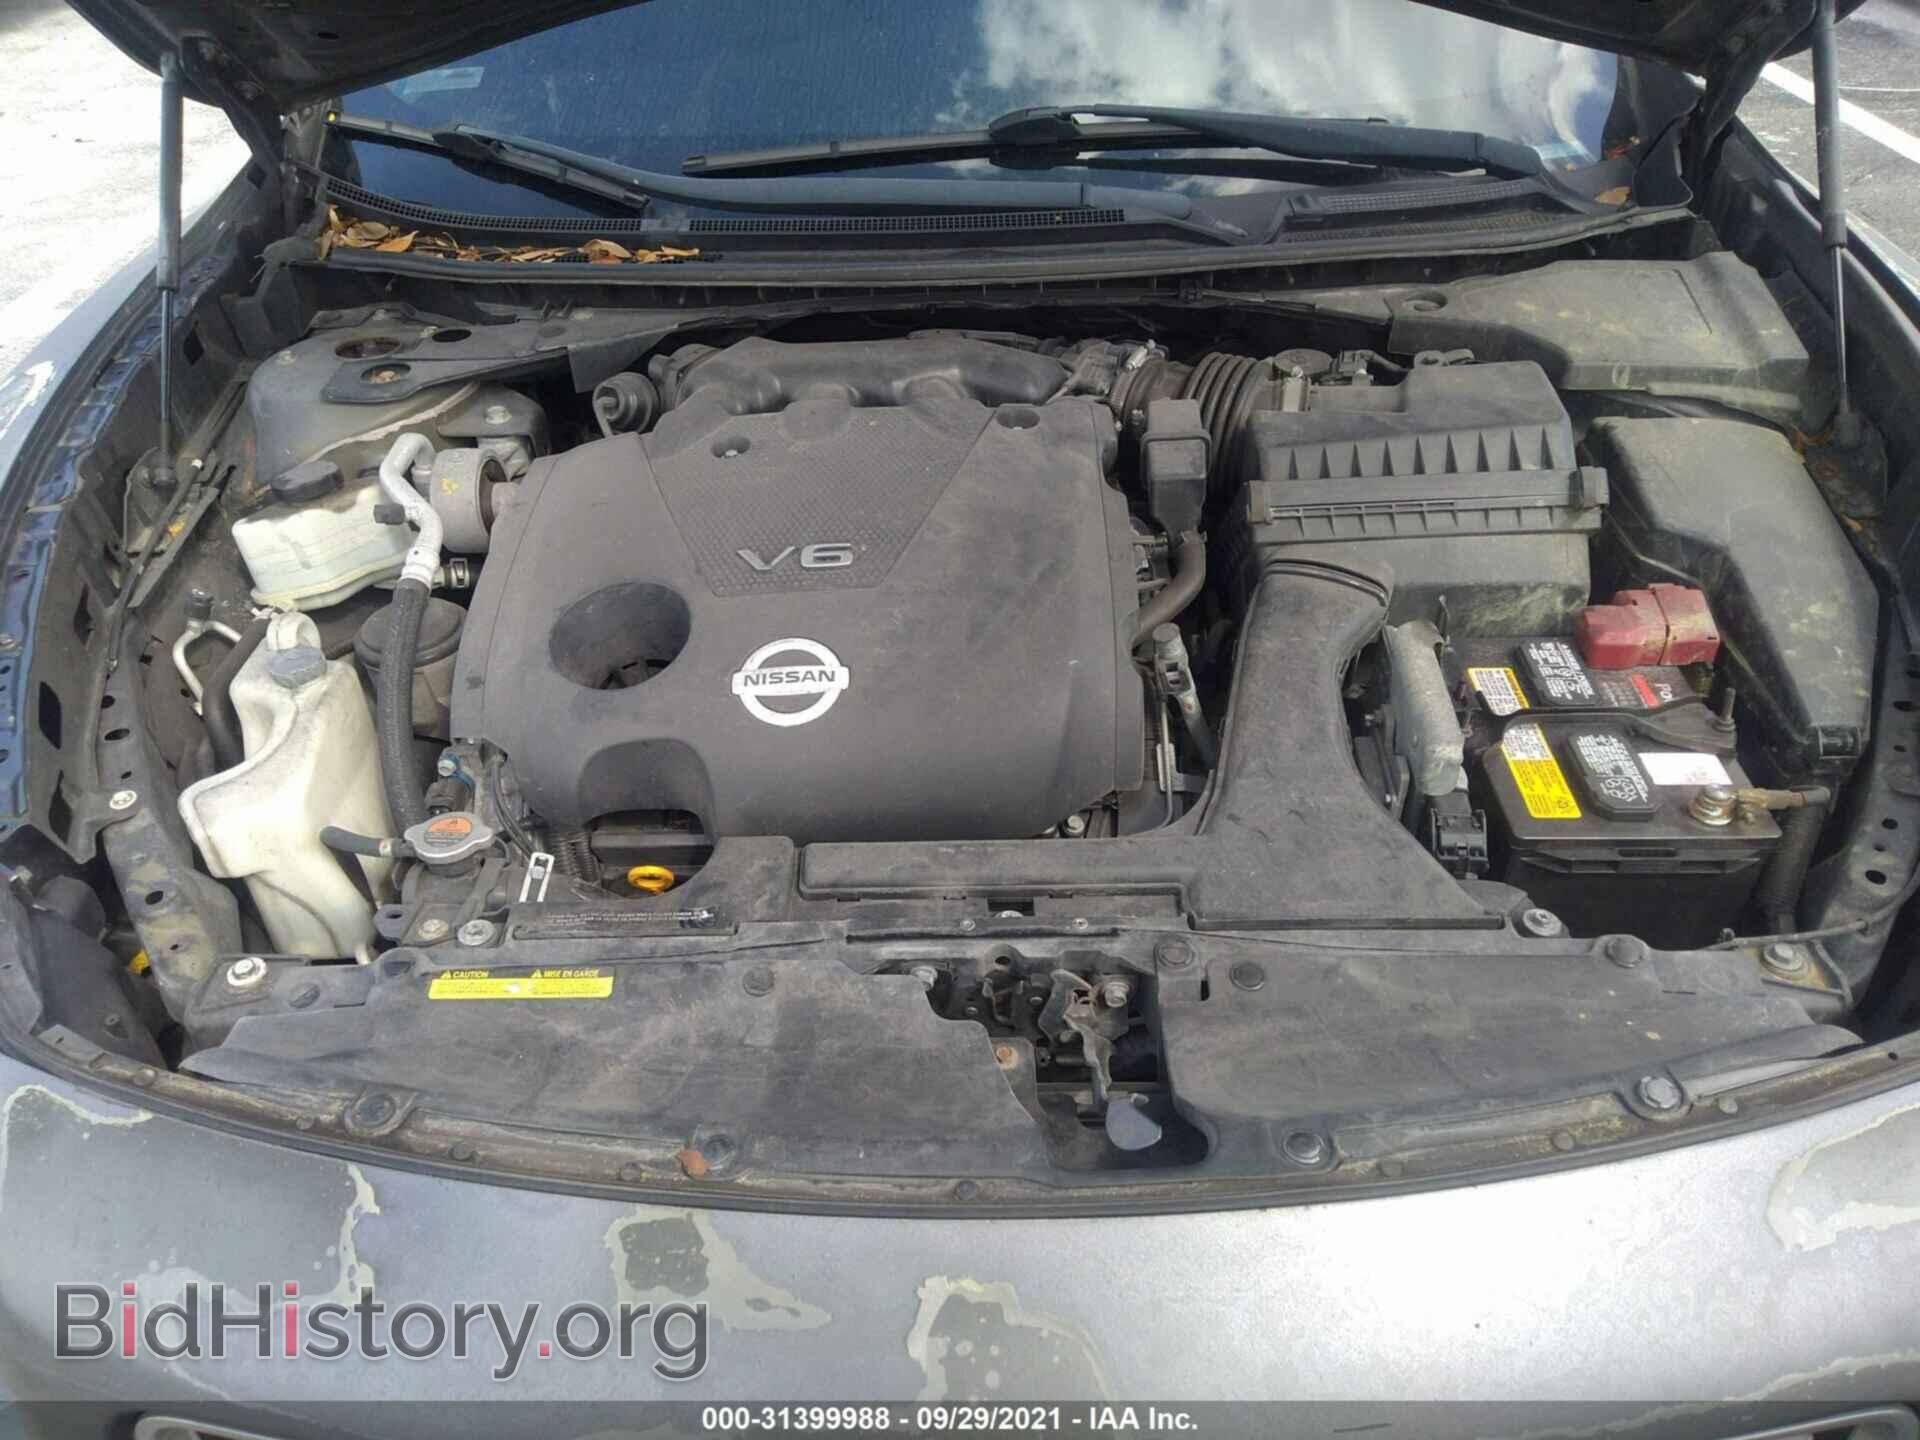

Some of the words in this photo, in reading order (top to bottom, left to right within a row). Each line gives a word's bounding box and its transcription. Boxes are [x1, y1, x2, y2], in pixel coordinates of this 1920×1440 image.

[735, 542, 853, 570] V6
[743, 669, 836, 687] NISSAN
[452, 970, 489, 979] CAUTION
